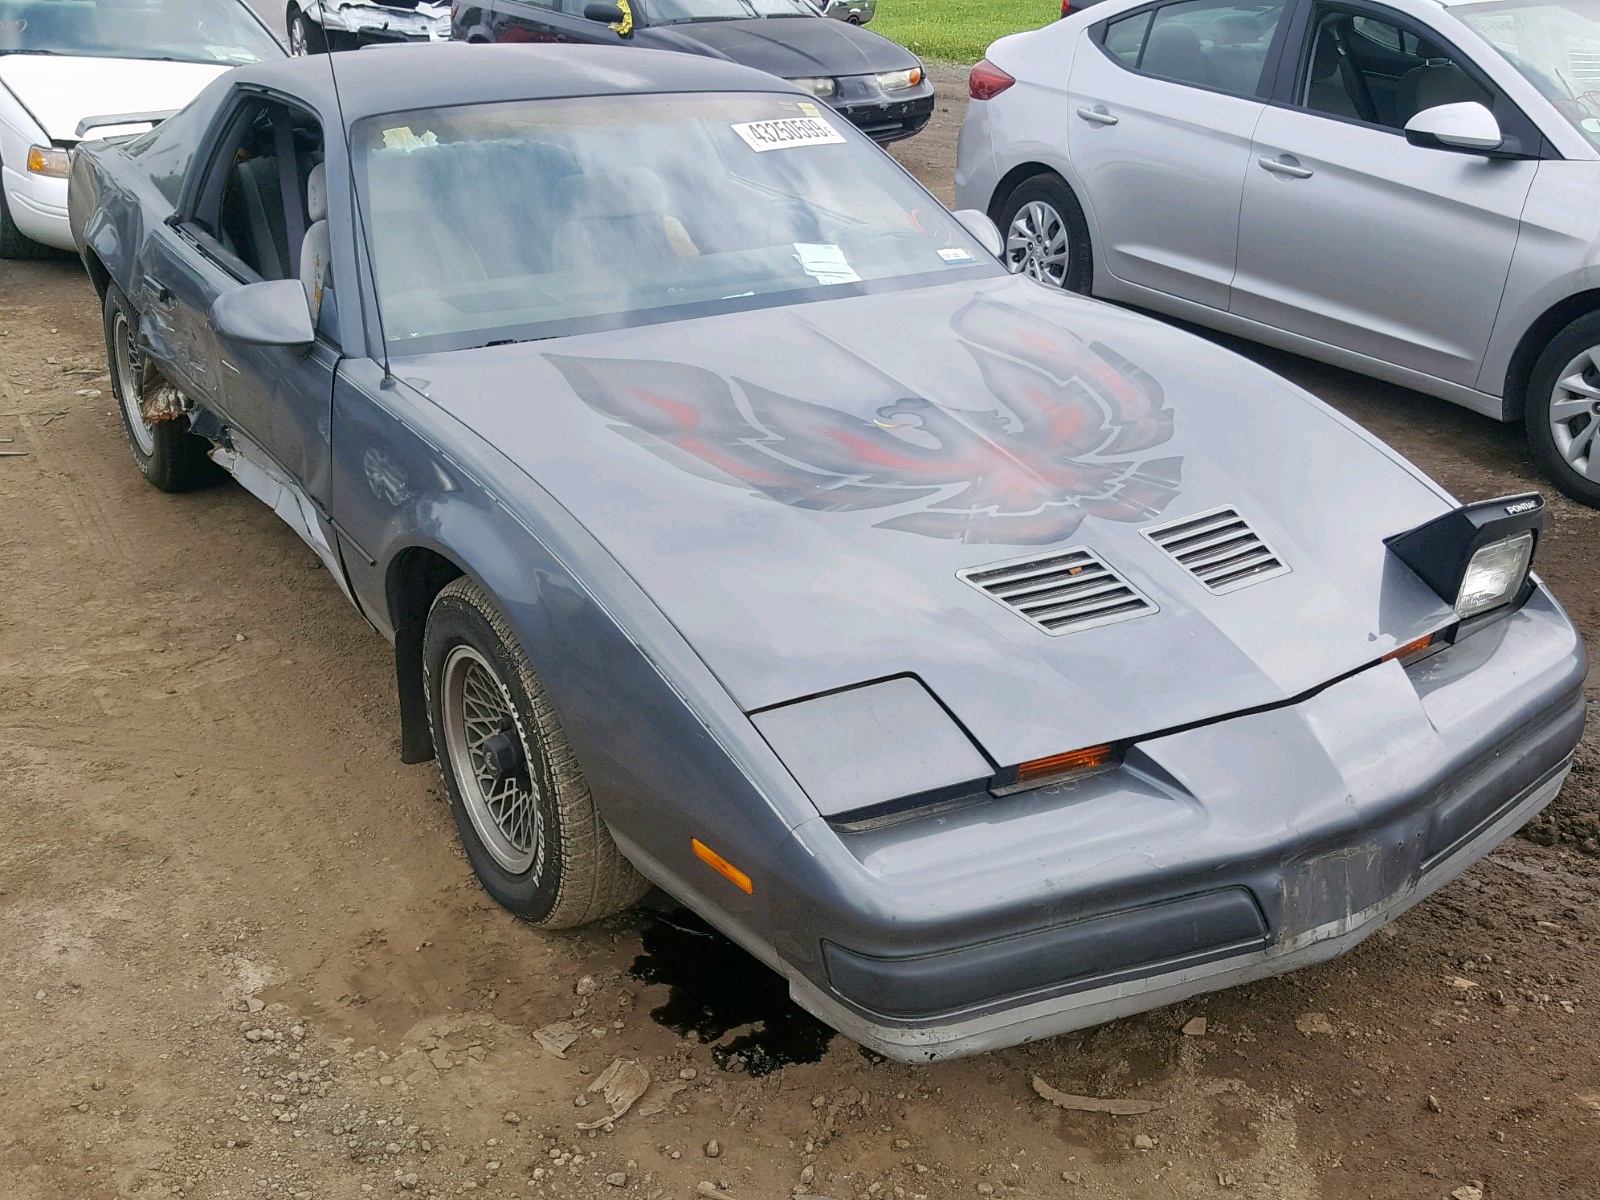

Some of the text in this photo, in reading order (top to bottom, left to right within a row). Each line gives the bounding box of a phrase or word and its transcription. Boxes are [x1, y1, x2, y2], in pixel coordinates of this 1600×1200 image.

[748, 119, 828, 143] 43250599
[1506, 500, 1537, 515] PONTIAC
[532, 810, 546, 888] COBRA
